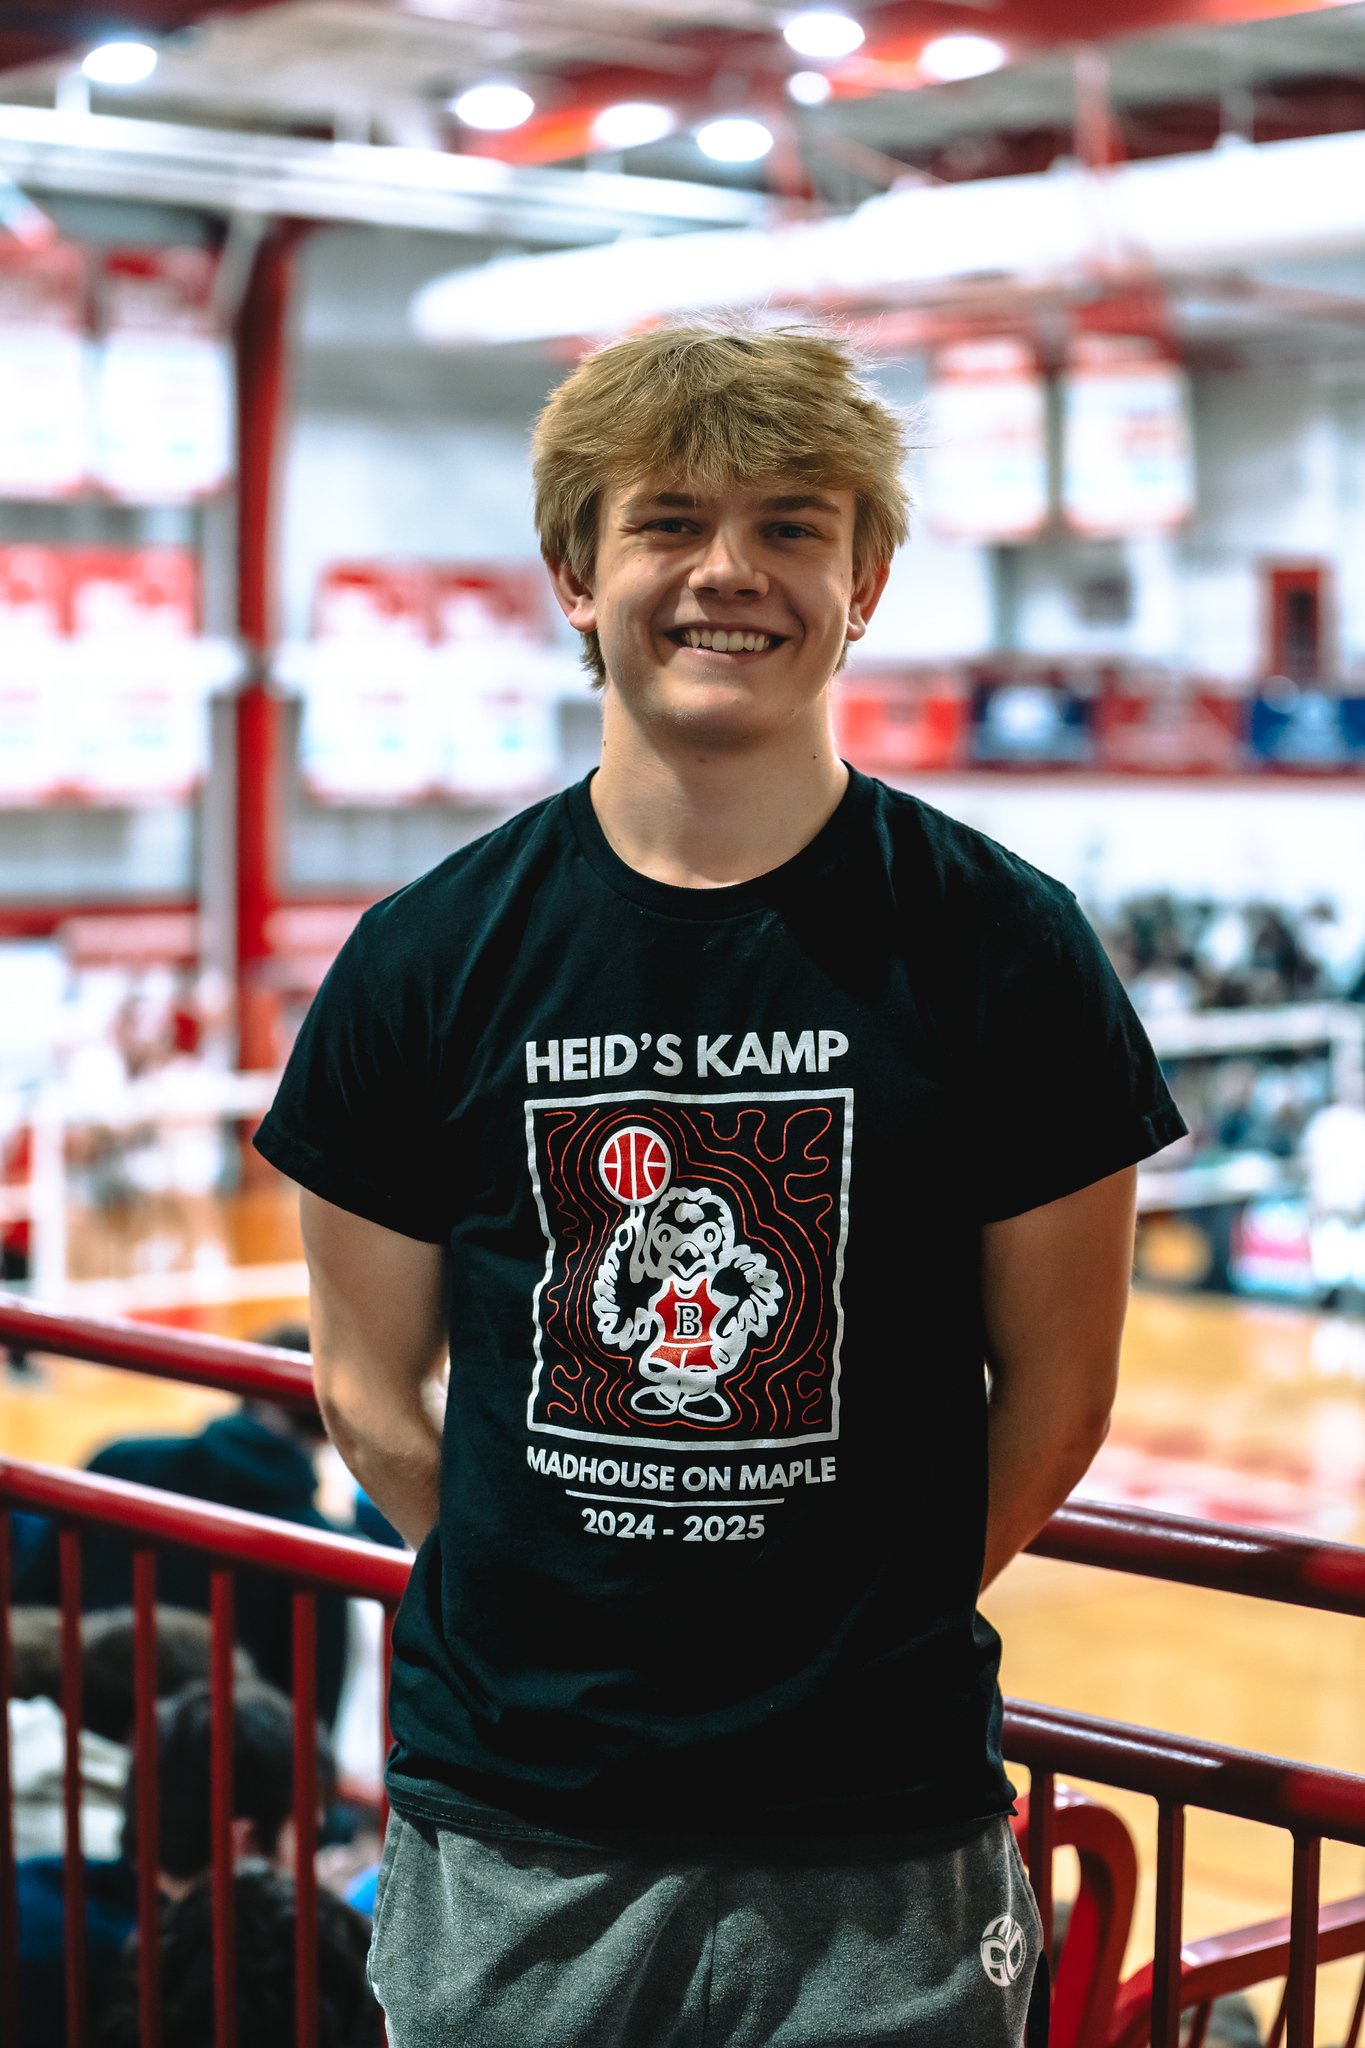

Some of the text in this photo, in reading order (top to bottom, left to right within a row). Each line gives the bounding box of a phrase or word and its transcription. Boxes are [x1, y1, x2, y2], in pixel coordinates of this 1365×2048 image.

[525, 1030, 850, 1084] HEID'S KAMP
[674, 1303, 702, 1339] B
[526, 1446, 837, 1492] MADHOUSE ON MAPLE
[581, 1508, 656, 1540] 2024
[682, 1514, 766, 1542] 2025
